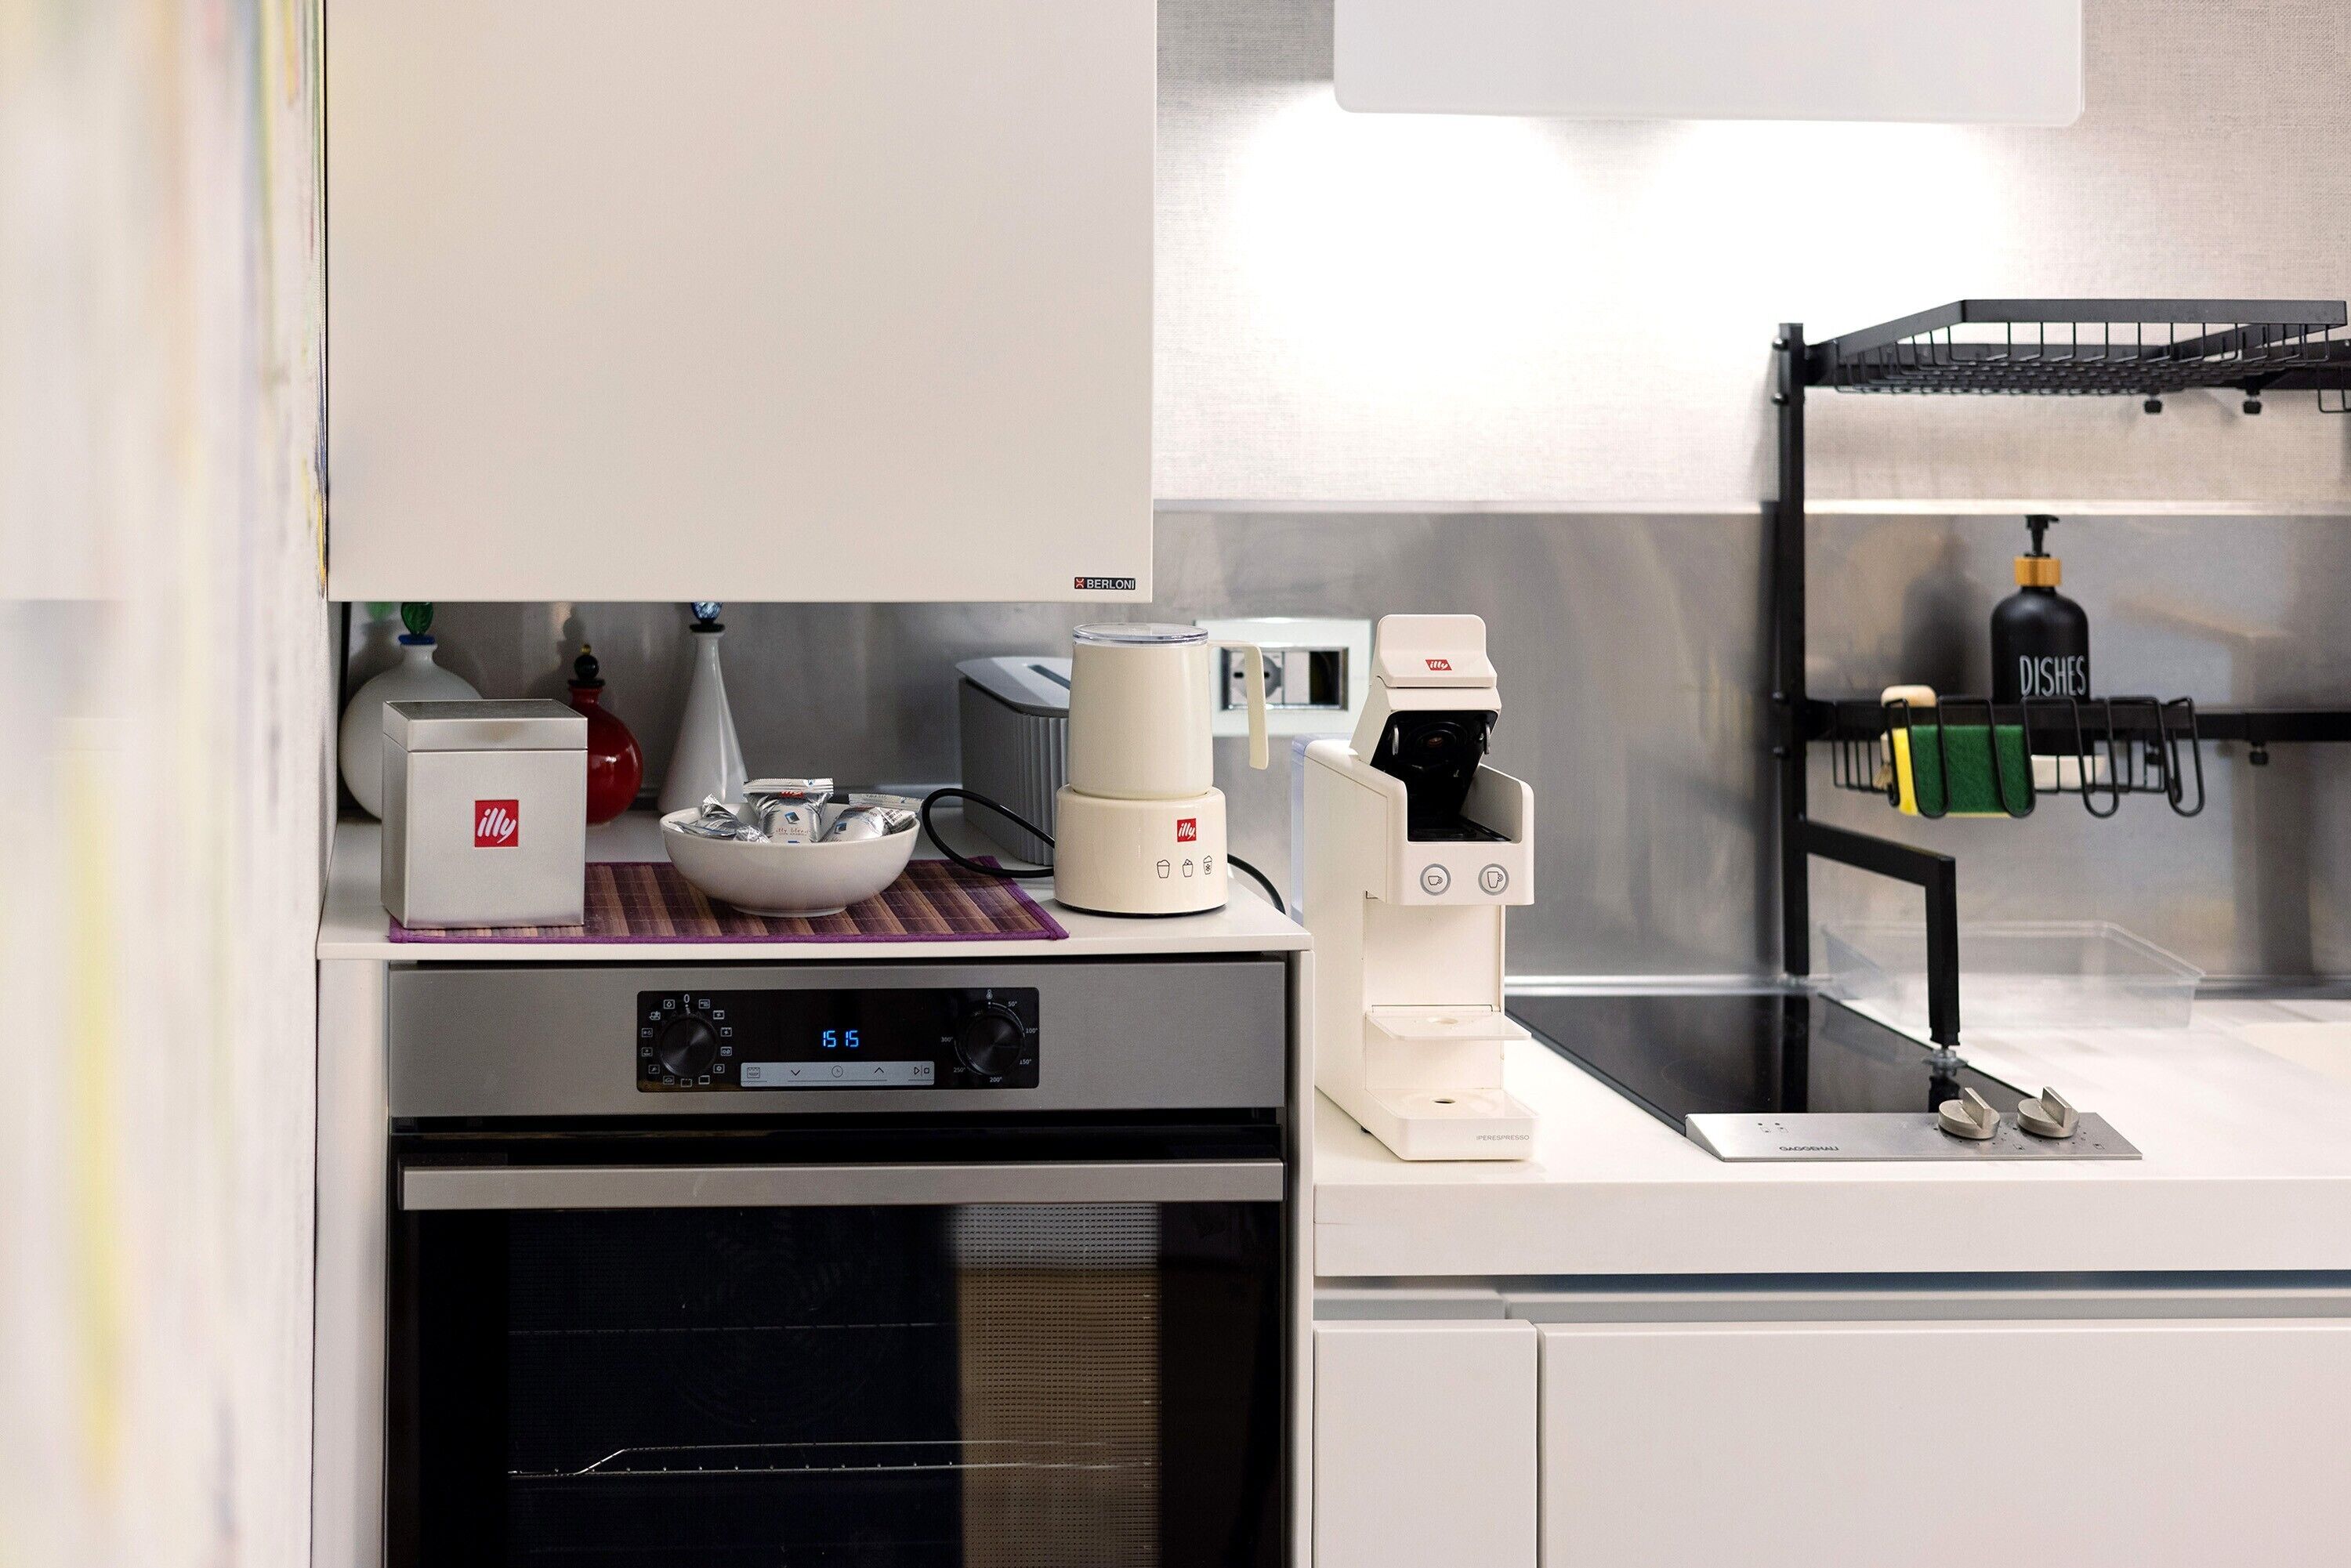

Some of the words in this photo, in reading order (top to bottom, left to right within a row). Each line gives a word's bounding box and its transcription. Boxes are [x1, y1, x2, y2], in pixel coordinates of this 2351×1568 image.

[1086, 579, 1135, 589] BERLONI
[1430, 660, 1448, 670] illy
[2020, 655, 2086, 697] DISHES
[477, 807, 516, 844] illy
[1178, 822, 1196, 840] illy
[823, 1030, 837, 1048] 15
[846, 1030, 859, 1048] 15
